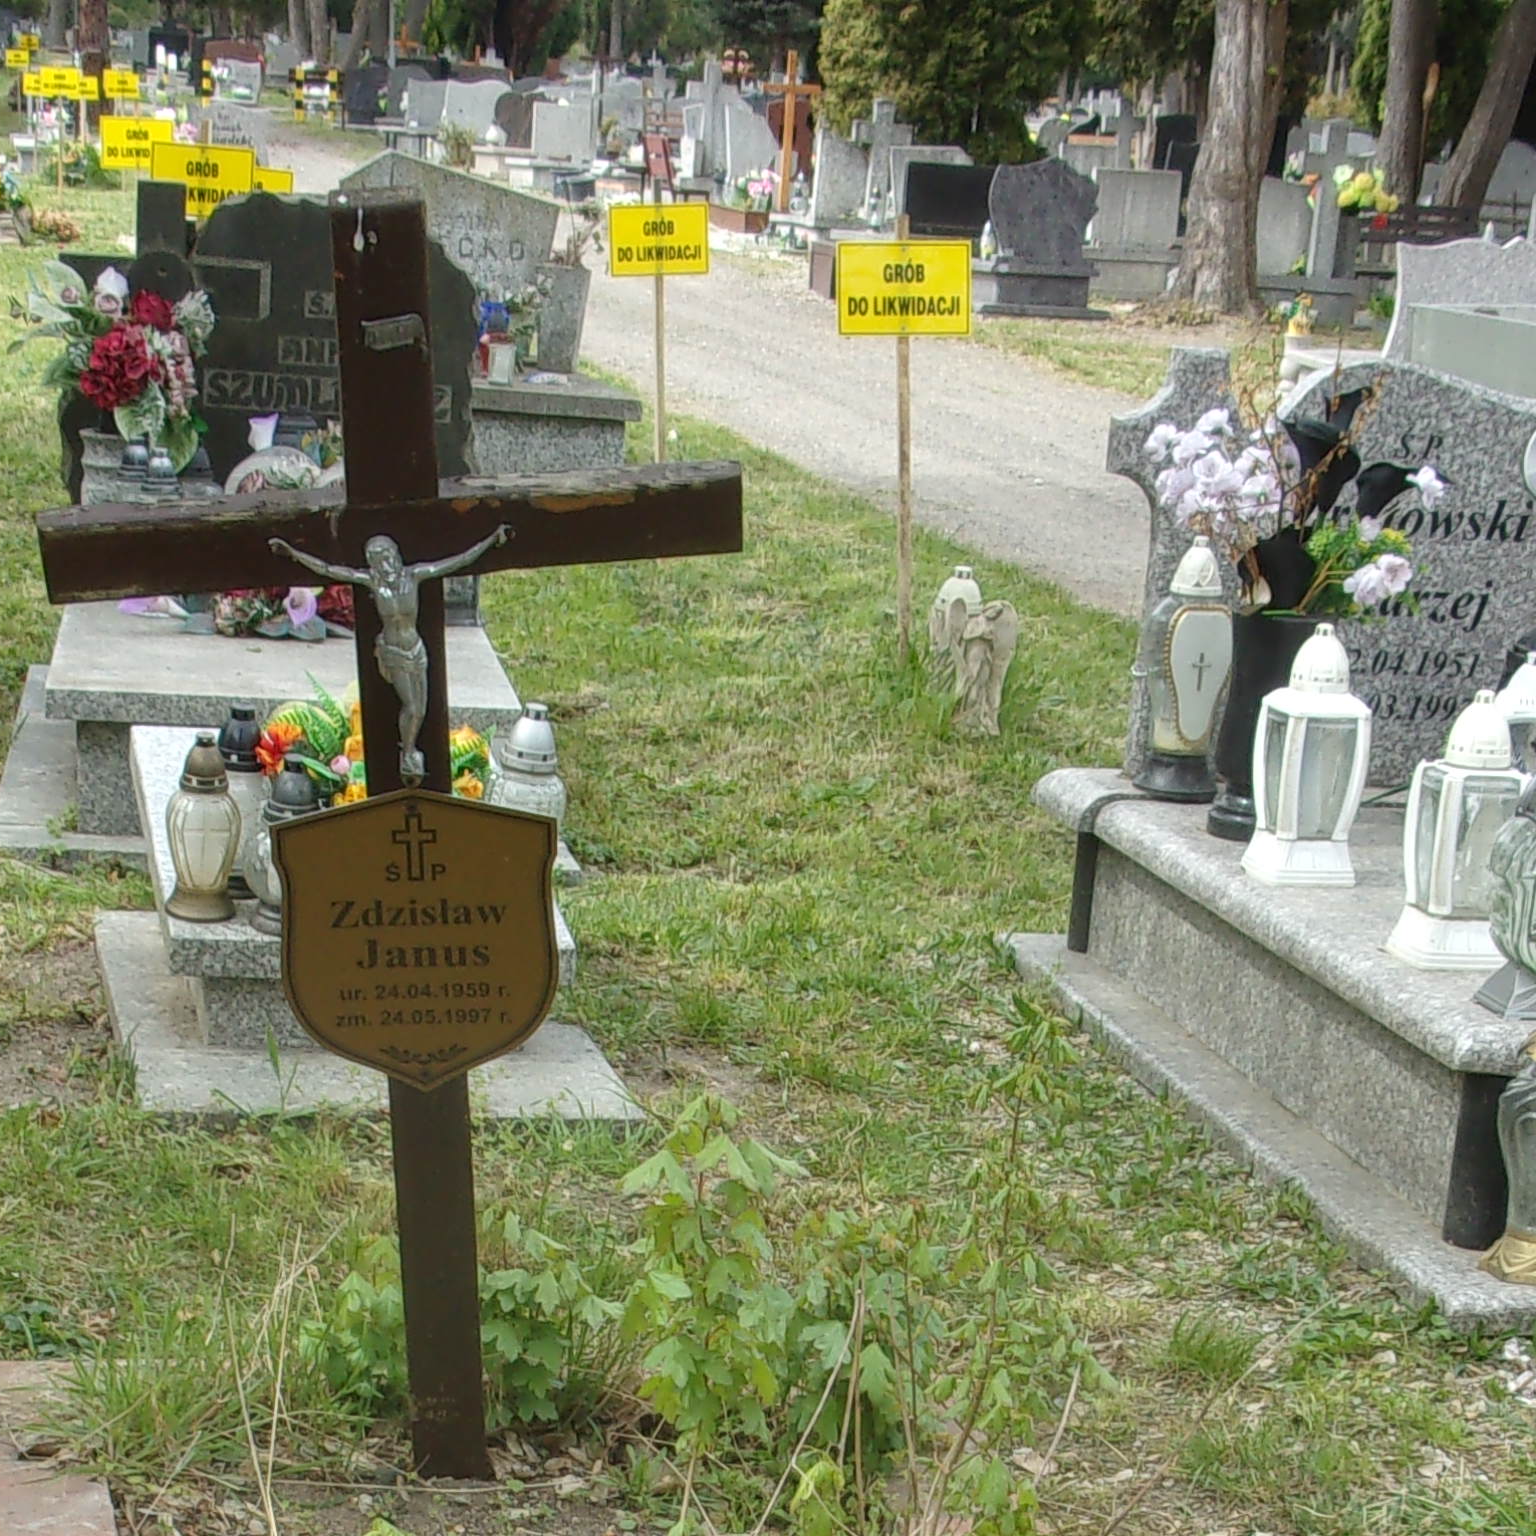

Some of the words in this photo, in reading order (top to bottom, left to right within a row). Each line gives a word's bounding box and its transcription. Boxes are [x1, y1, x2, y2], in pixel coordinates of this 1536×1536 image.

[126, 127, 149, 141] GRÓB
[107, 147, 119, 159] DO
[120, 147, 151, 159] LIKWID
[186, 159, 219, 178] GRÓB
[643, 217, 675, 237] GRÓB
[617, 245, 634, 263] DO
[636, 243, 702, 263] LIKWIDACJI
[883, 257, 925, 284] GRÓB
[848, 296, 869, 315] DO
[873, 294, 961, 318] LIKWIDACJI
[385, 861, 401, 882] Ś
[431, 864, 447, 881] P
[356, 939, 491, 970] Janus
[338, 988, 367, 1002] ur.
[375, 983, 490, 1000] 24.04.1959
[498, 985, 511, 998] r.
[335, 1014, 372, 1028] zm.
[380, 1009, 491, 1026] 24.05.1997
[499, 1012, 512, 1024] r.
